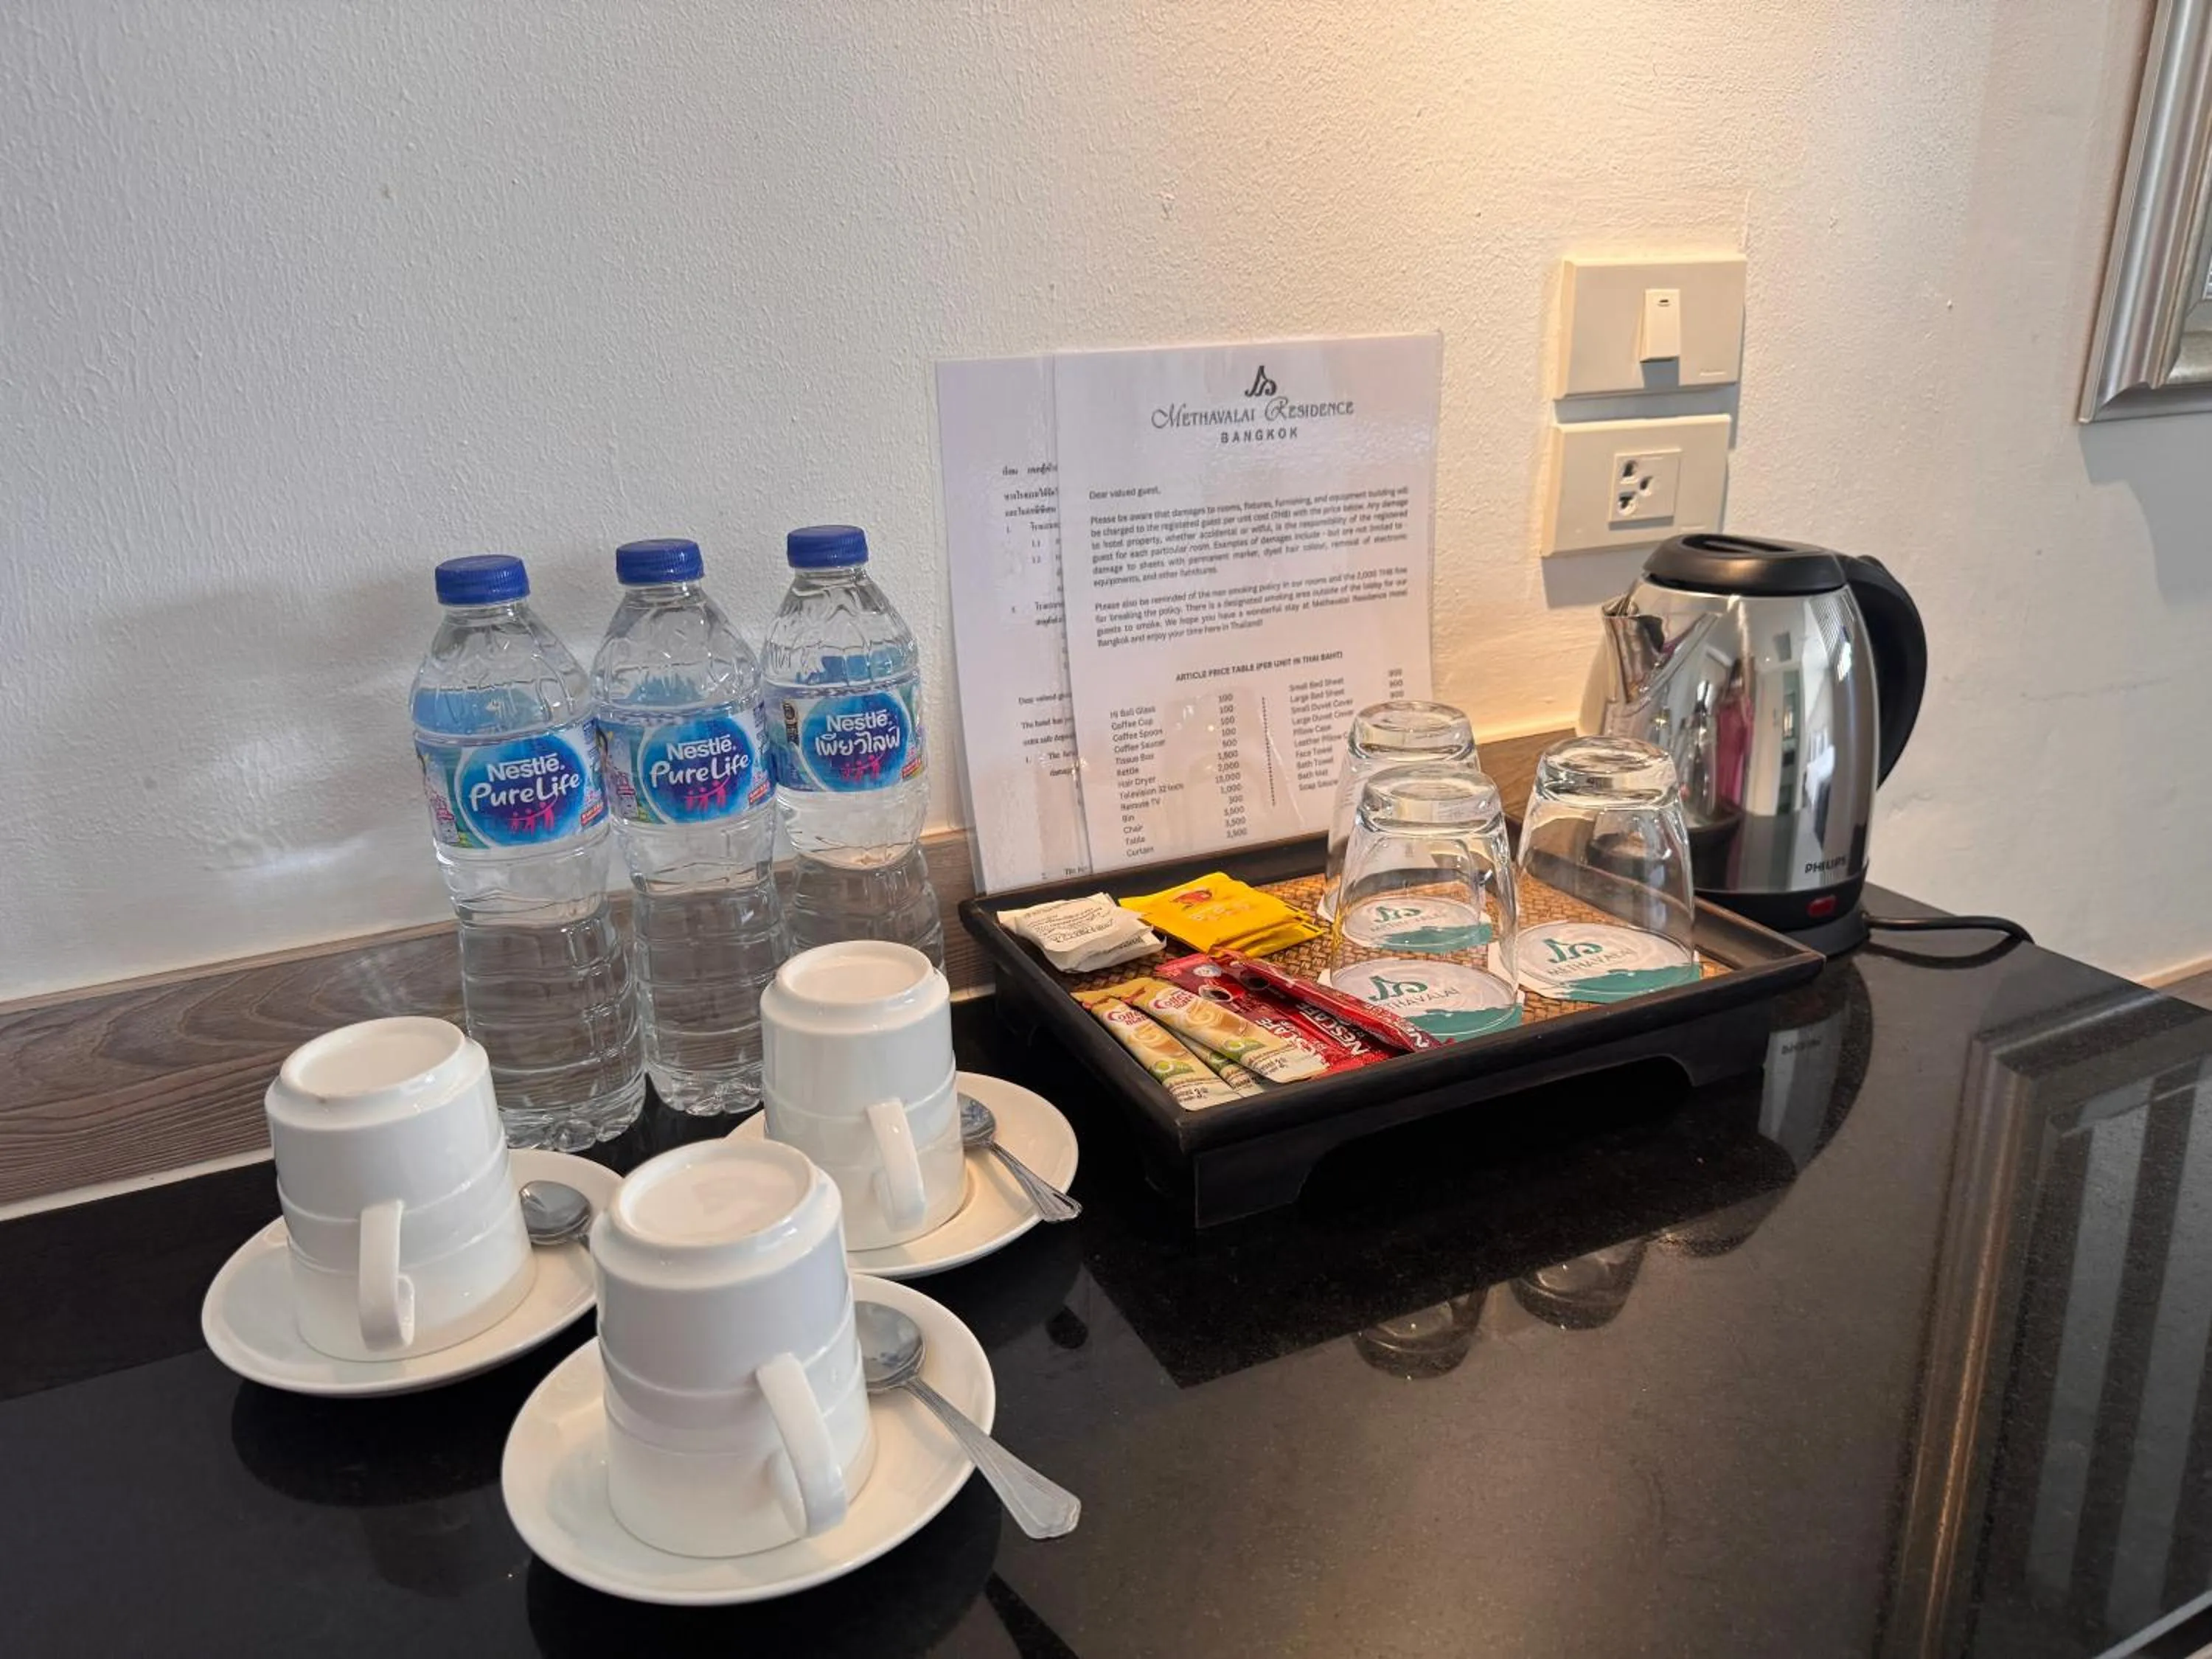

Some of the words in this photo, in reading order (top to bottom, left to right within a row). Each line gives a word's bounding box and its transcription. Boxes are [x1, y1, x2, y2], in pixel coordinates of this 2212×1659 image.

[1151, 403, 1256, 429] METHAVALAI
[1264, 397, 1354, 422] RESIDENCE
[1220, 427, 1298, 444] BANGKOK
[1176, 669, 1206, 681] ARTICLE
[1208, 666, 1229, 676] PRICE
[1232, 662, 1253, 672] TABLE
[1256, 660, 1272, 671] (PER
[1273, 657, 1290, 667] UNIT
[1303, 653, 1318, 663] THAI
[1321, 650, 1342, 661] BAHT)
[827, 709, 892, 732] Nestlé
[667, 734, 735, 761] Nestlé
[487, 753, 564, 782] Nestlé
[1804, 855, 1846, 874] PHILIPS
